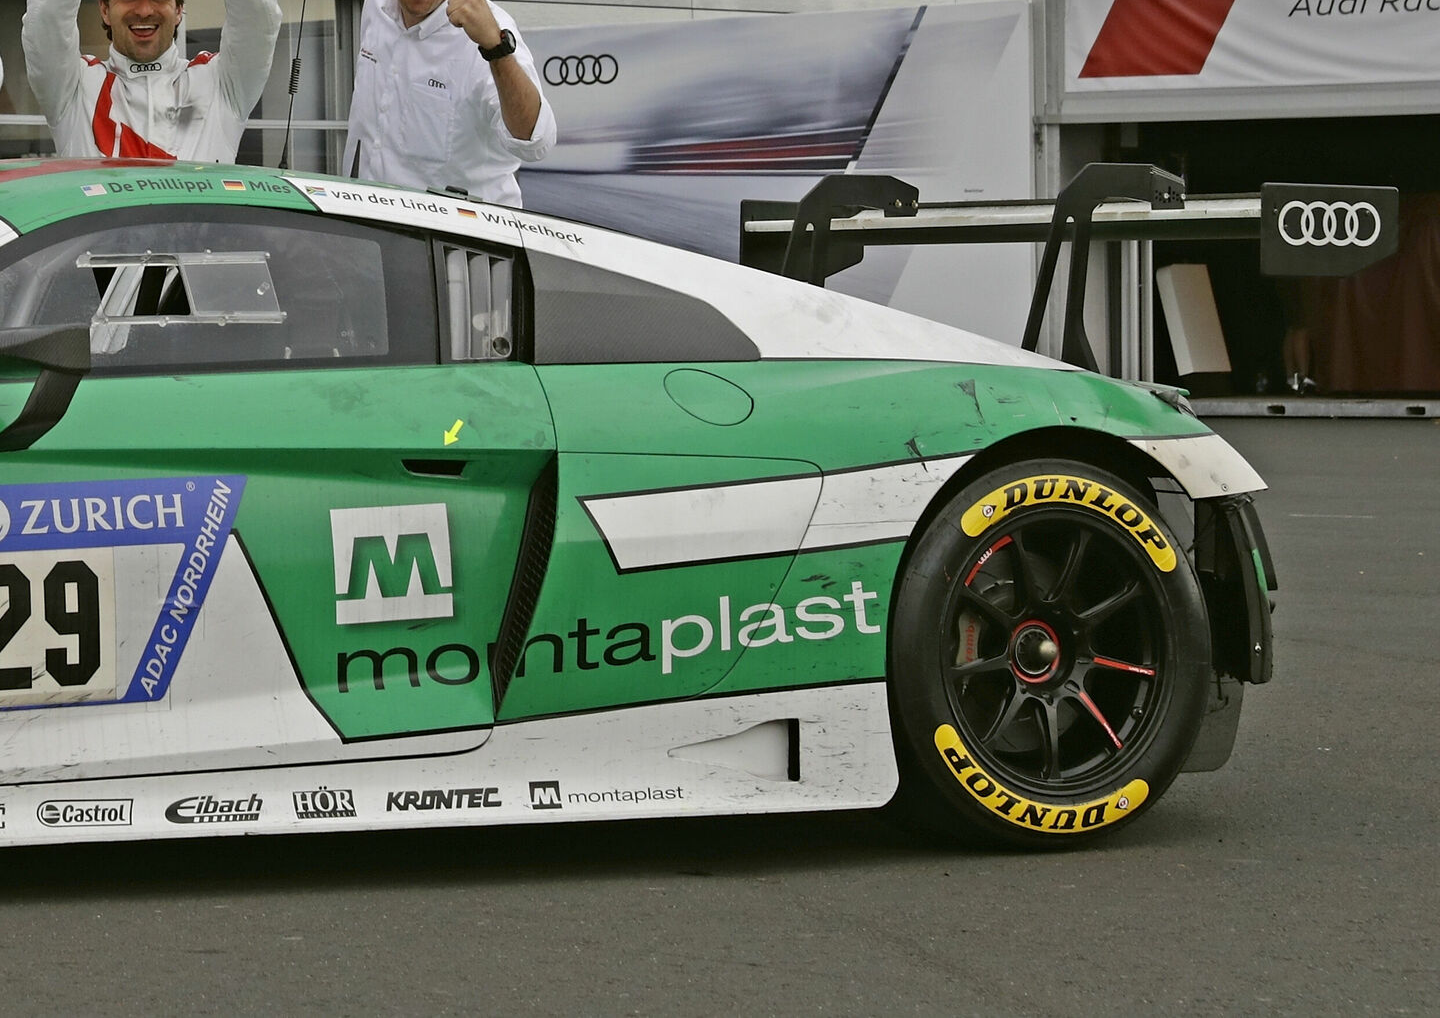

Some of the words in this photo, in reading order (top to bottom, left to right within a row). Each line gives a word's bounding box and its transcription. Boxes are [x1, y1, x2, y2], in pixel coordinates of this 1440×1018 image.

[108, 181, 133, 194] De
[137, 178, 214, 198] Phillippi
[249, 180, 292, 195] Mies
[330, 190, 363, 203] van
[368, 193, 396, 207] der
[401, 198, 449, 216] Linde
[481, 211, 586, 246] Winkelhock
[19, 493, 185, 536] ZURICH
[1002, 478, 1168, 551] DUNLOP
[140, 624, 178, 698] ADAC
[169, 479, 233, 624] NORDRHEIN
[337, 581, 882, 694] montaplast
[294, 786, 355, 813] HÖR
[386, 787, 503, 812] KRONTEC
[568, 786, 684, 804] montaplast
[943, 747, 1110, 830] DUNLOP
[62, 804, 126, 824] Castrol
[164, 793, 263, 824] Eibach
